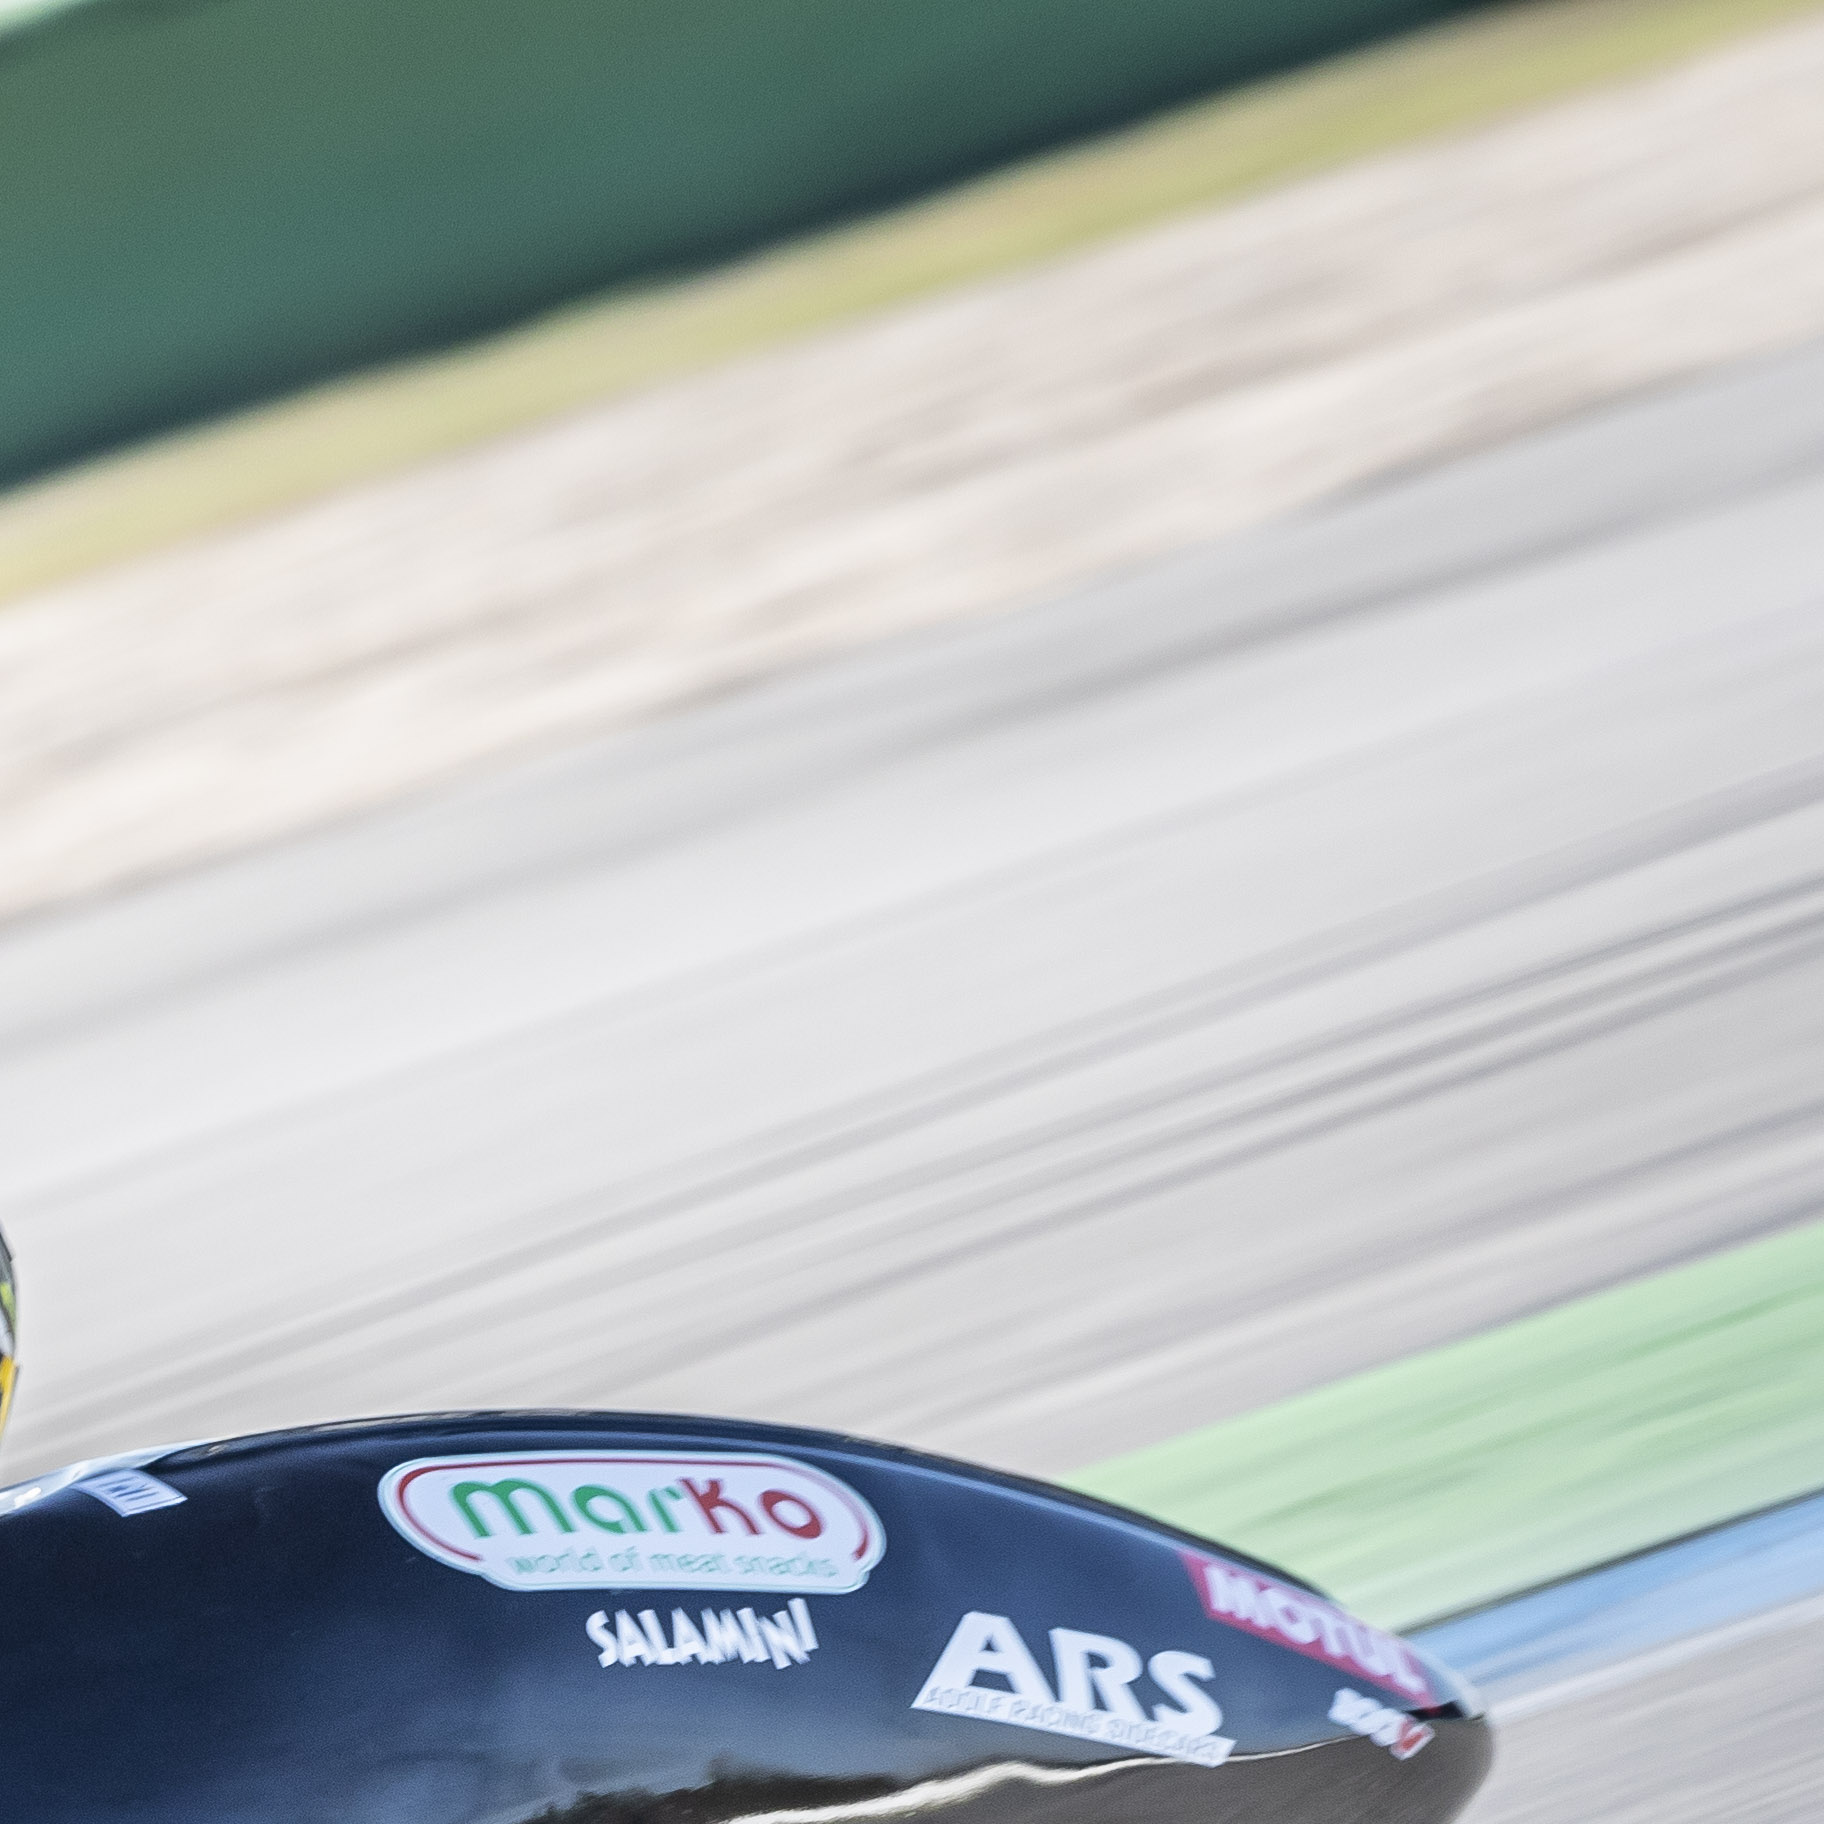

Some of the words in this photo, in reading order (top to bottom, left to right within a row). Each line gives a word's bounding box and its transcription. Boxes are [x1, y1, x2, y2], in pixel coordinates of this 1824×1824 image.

[585, 1597, 820, 1670] SALAMINI
[910, 1610, 1223, 1738] ARS
[1204, 1565, 1428, 1694] MOTUL
